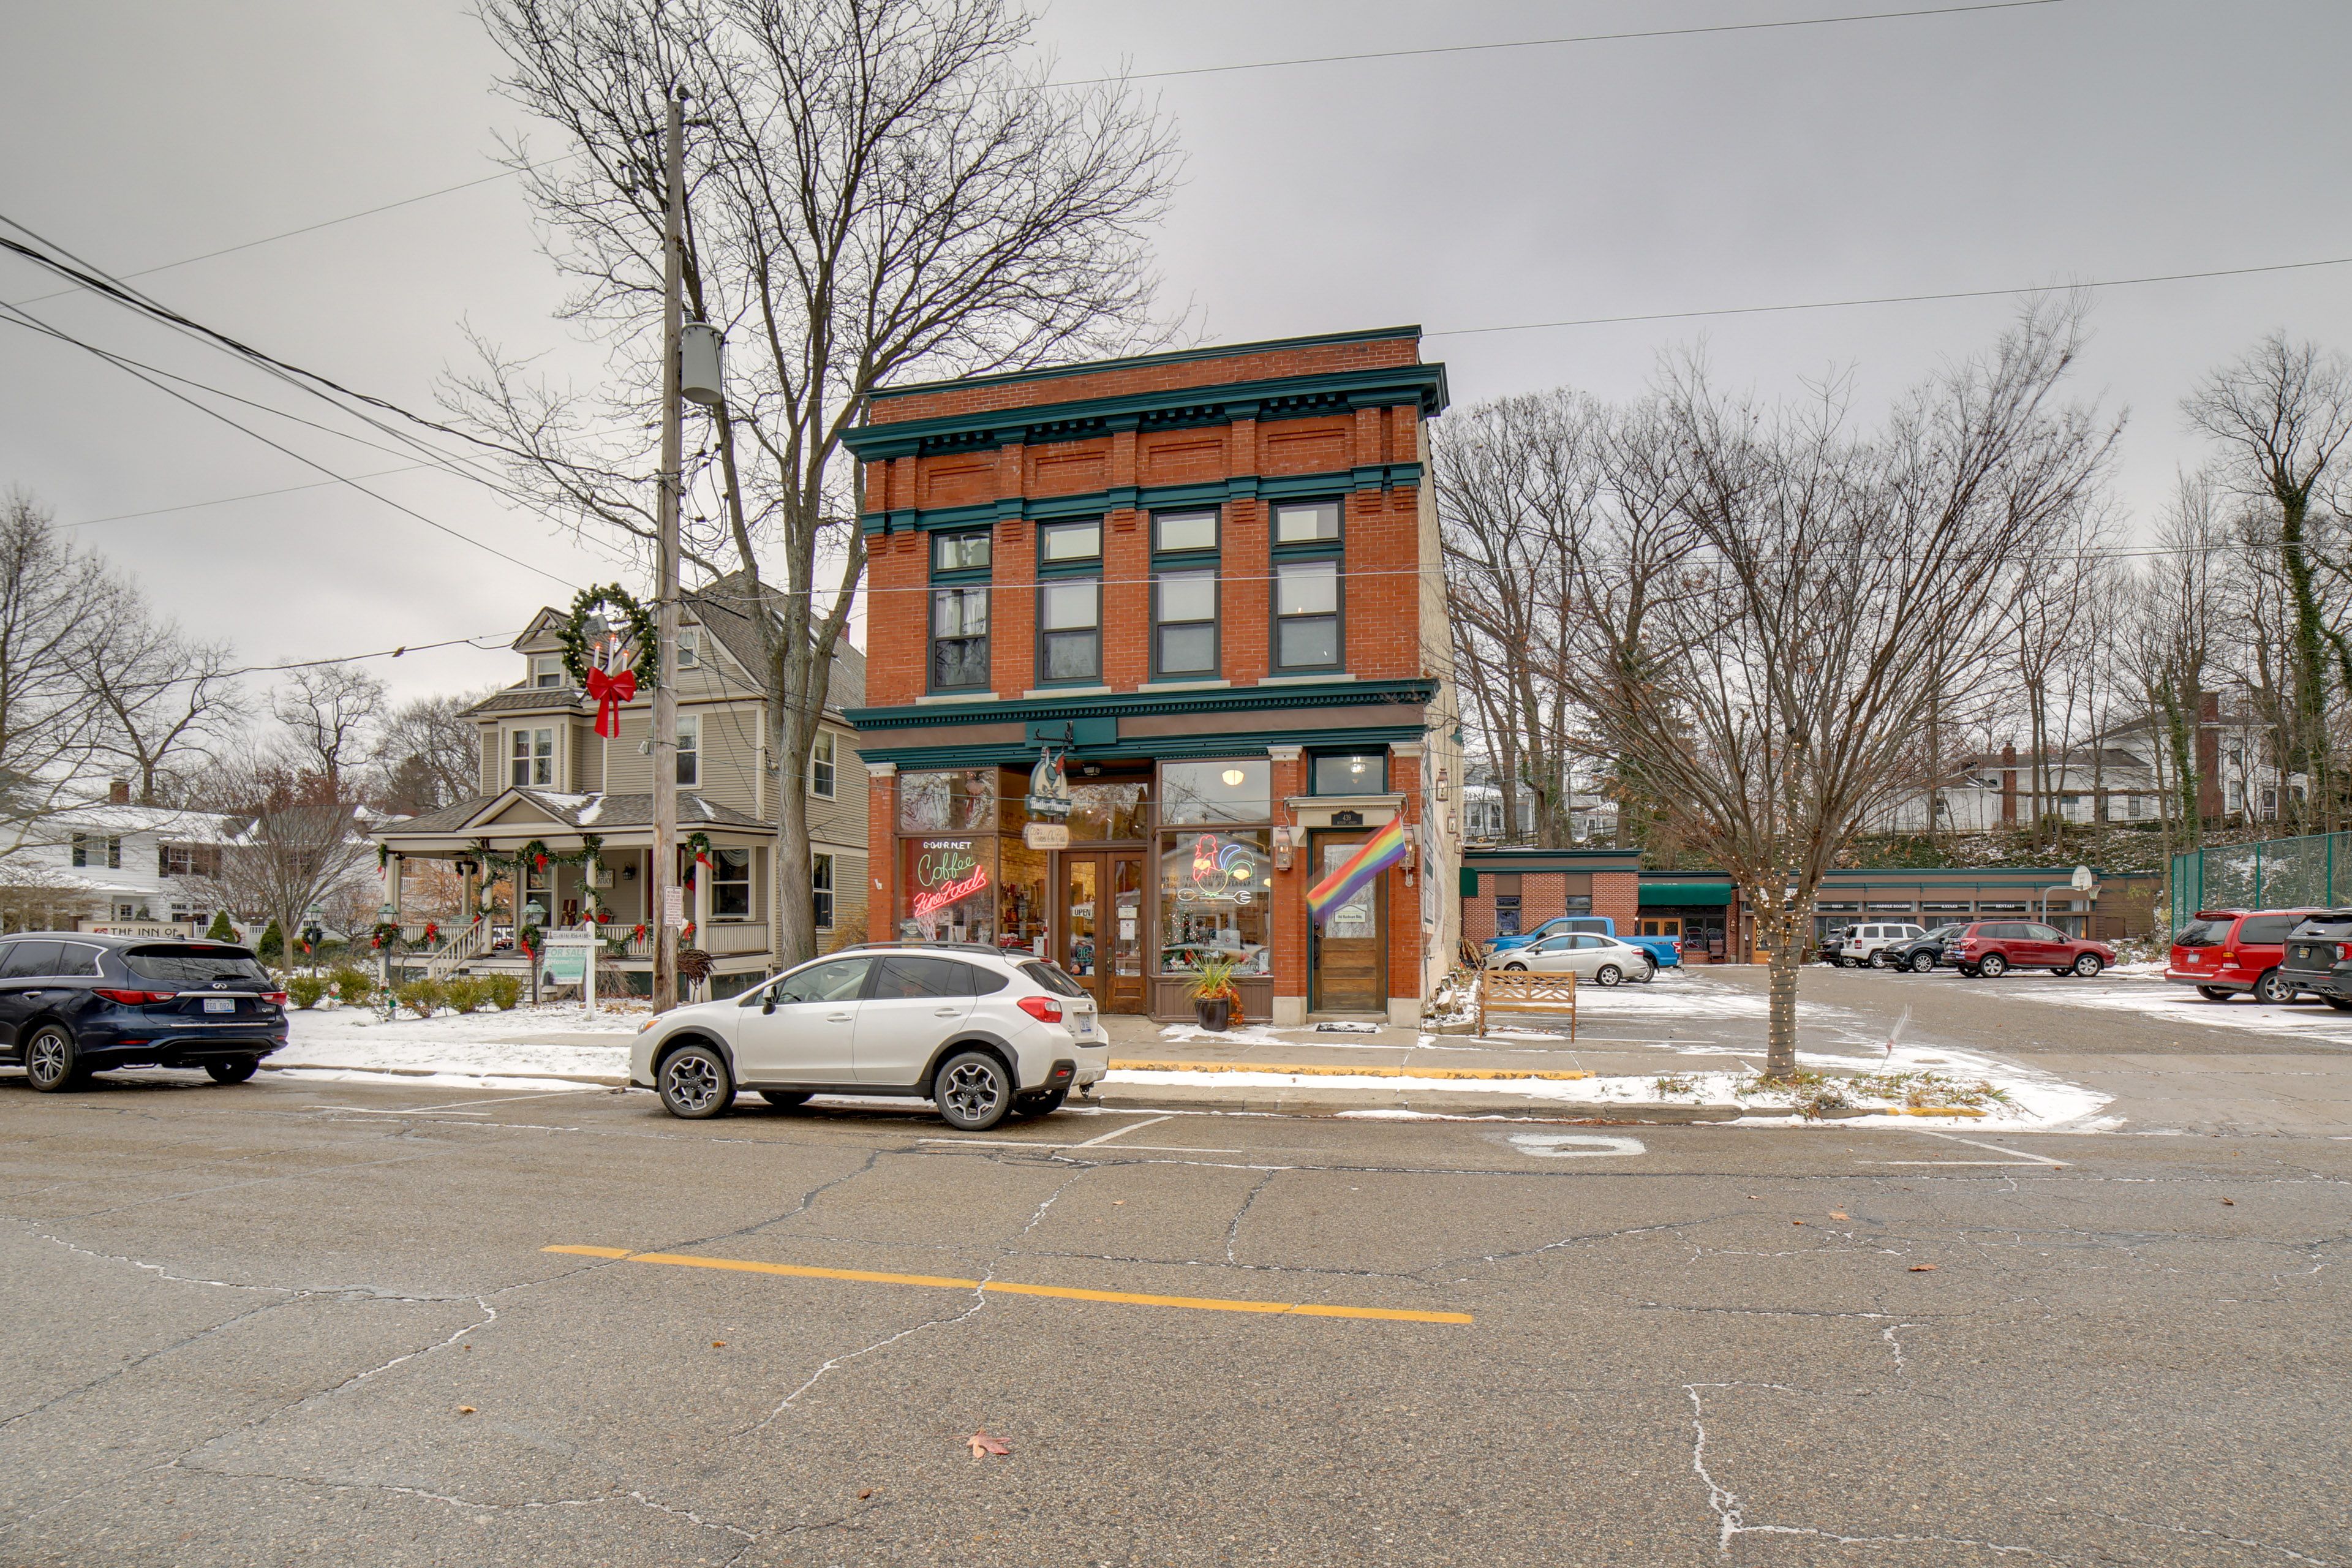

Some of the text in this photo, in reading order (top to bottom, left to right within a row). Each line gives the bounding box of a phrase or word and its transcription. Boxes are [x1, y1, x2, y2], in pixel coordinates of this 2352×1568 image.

[918, 852, 976, 887] Coffee
[913, 865, 987, 917] Fine Foods
[138, 929, 159, 937] INN
[164, 928, 178, 938] OF
